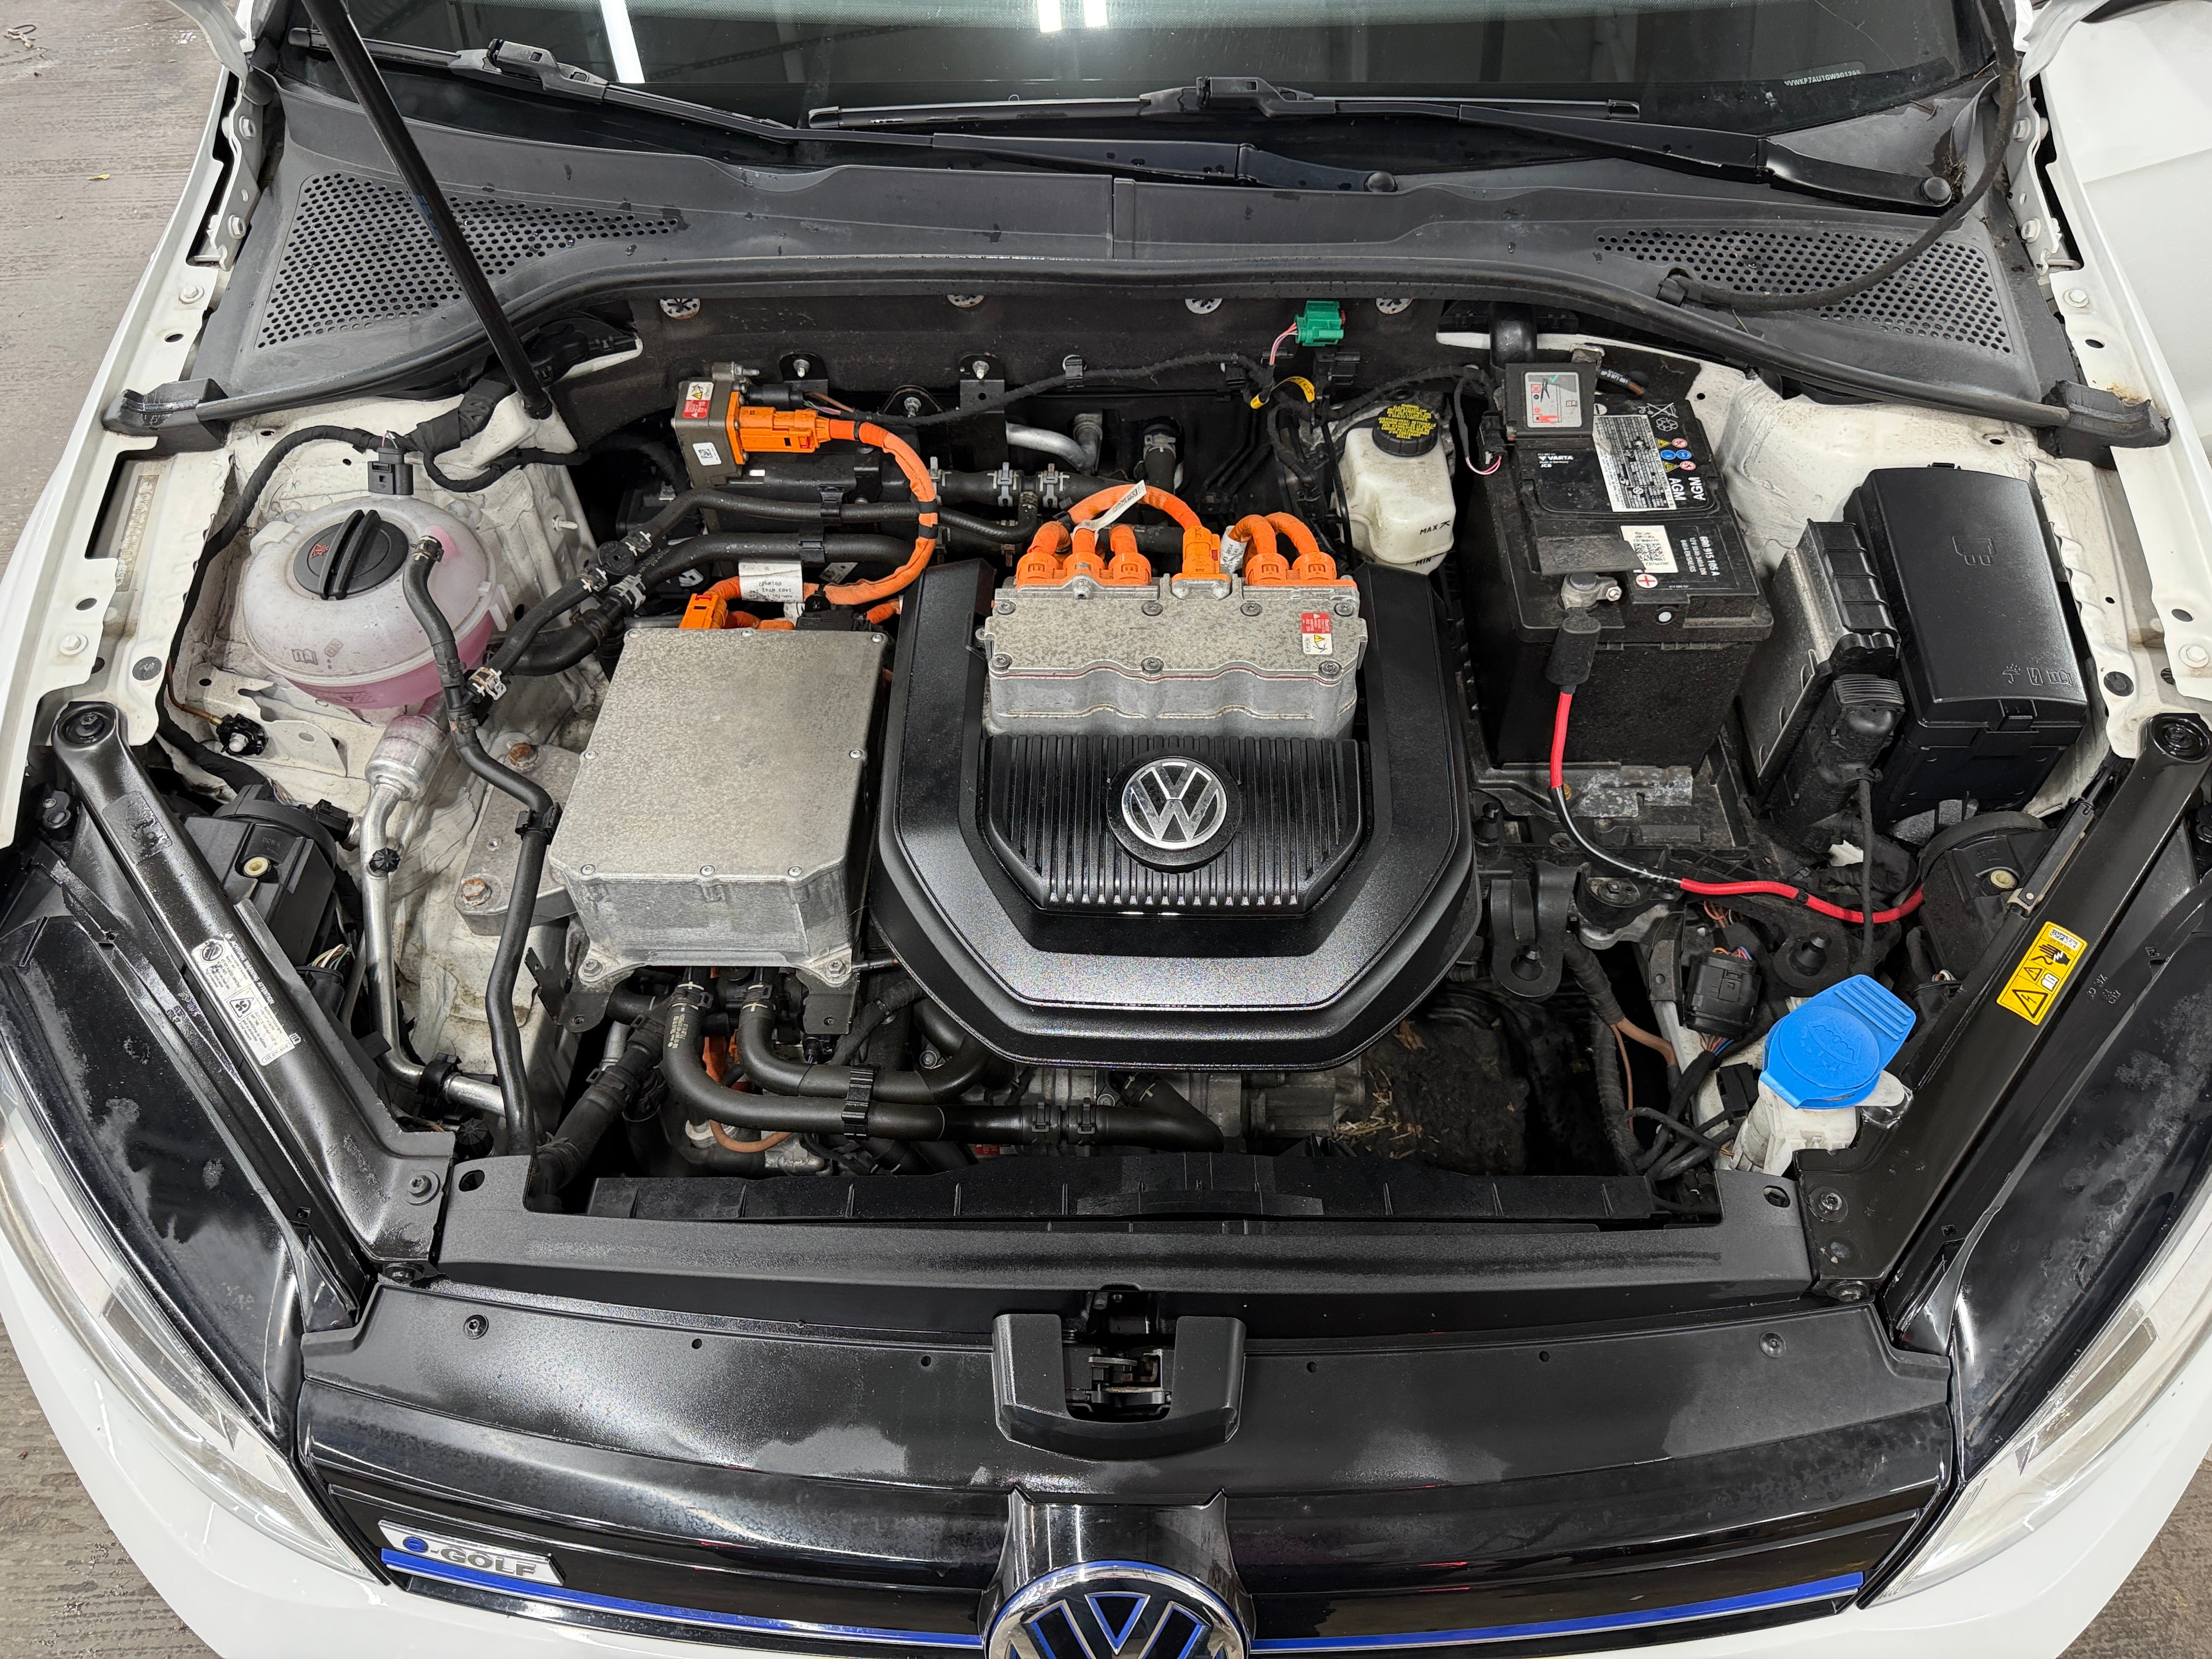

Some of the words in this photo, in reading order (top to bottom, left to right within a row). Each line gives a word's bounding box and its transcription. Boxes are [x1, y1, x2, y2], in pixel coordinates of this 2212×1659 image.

[1669, 478, 1687, 501] AGM
[1688, 477, 1707, 501] AGM
[1420, 524, 1438, 535] MAX
[1415, 556, 1432, 566] MIN
[1703, 548, 1716, 559] 915
[1707, 560, 1719, 571] 105
[230, 940, 246, 962] ACHTUNG
[243, 959, 260, 982] WARNING
[257, 981, 275, 1005] ATTENTION
[403, 1536, 537, 1576] e-GOLF
